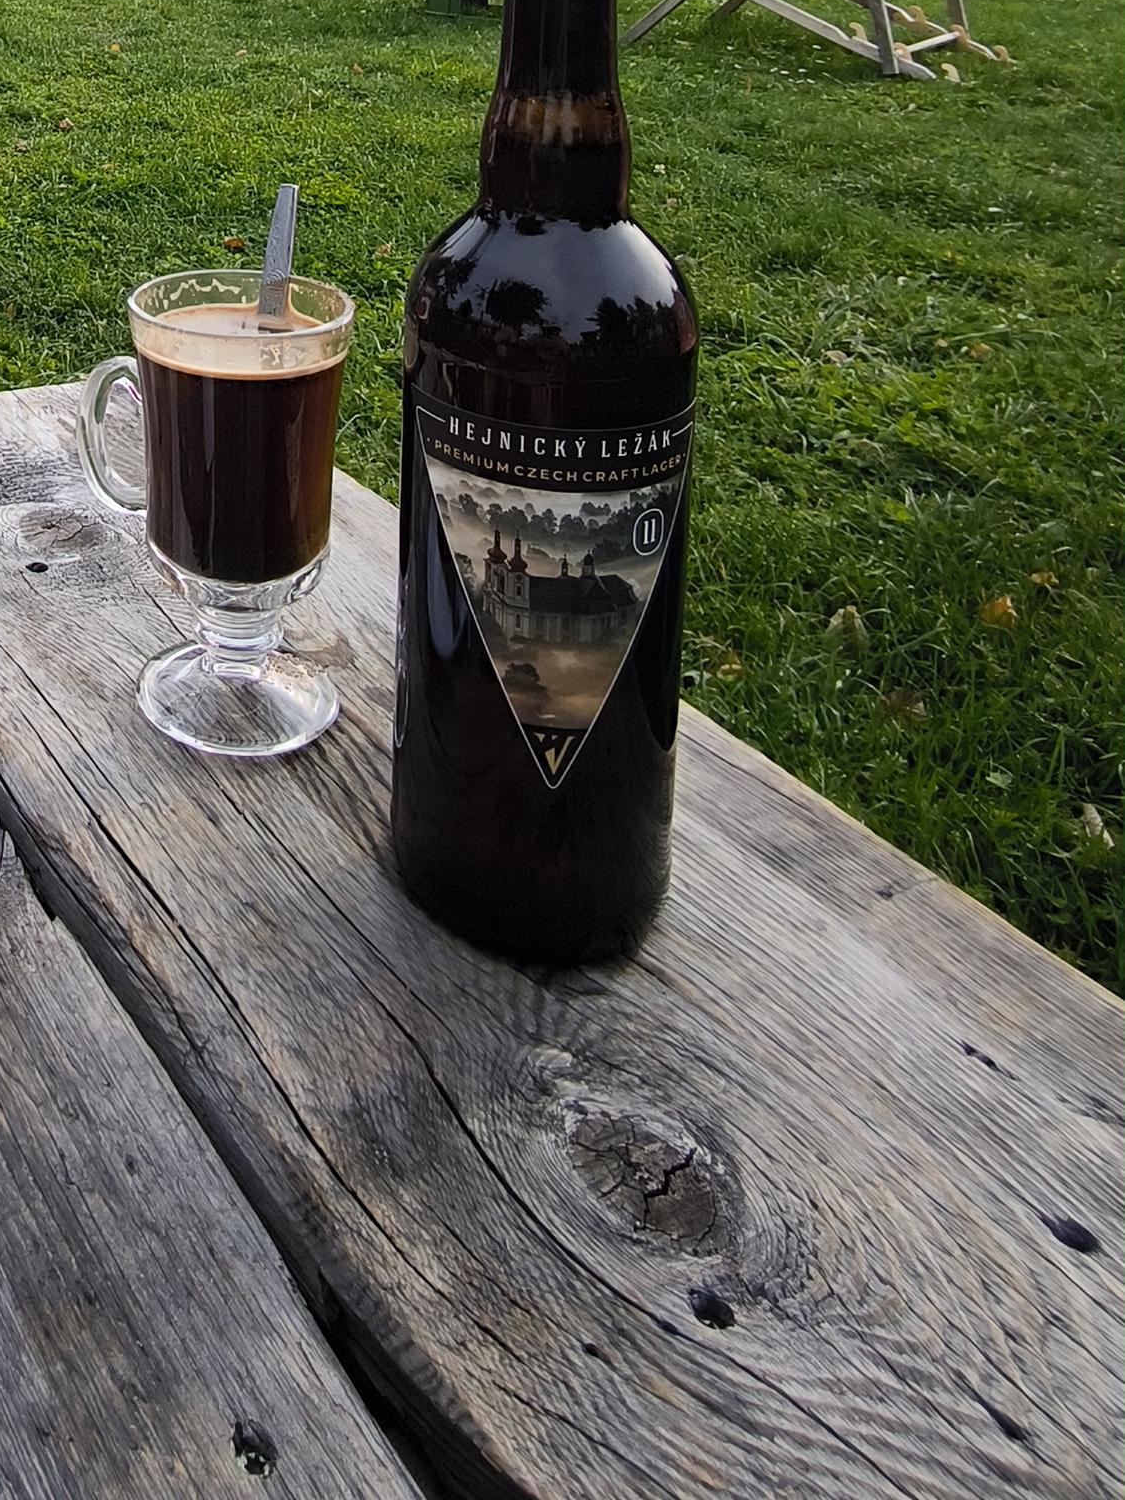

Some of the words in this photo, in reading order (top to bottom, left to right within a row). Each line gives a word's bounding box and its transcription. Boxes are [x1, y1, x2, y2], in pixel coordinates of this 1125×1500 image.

[449, 415, 586, 458] HEJNICKÝ
[601, 429, 671, 458] LEŽÁK
[435, 439, 509, 474] PREMIUM
[514, 465, 578, 482] CZECH
[582, 467, 640, 482] CRAFT
[642, 454, 681, 477] LAGER
[643, 518, 656, 545] 11
